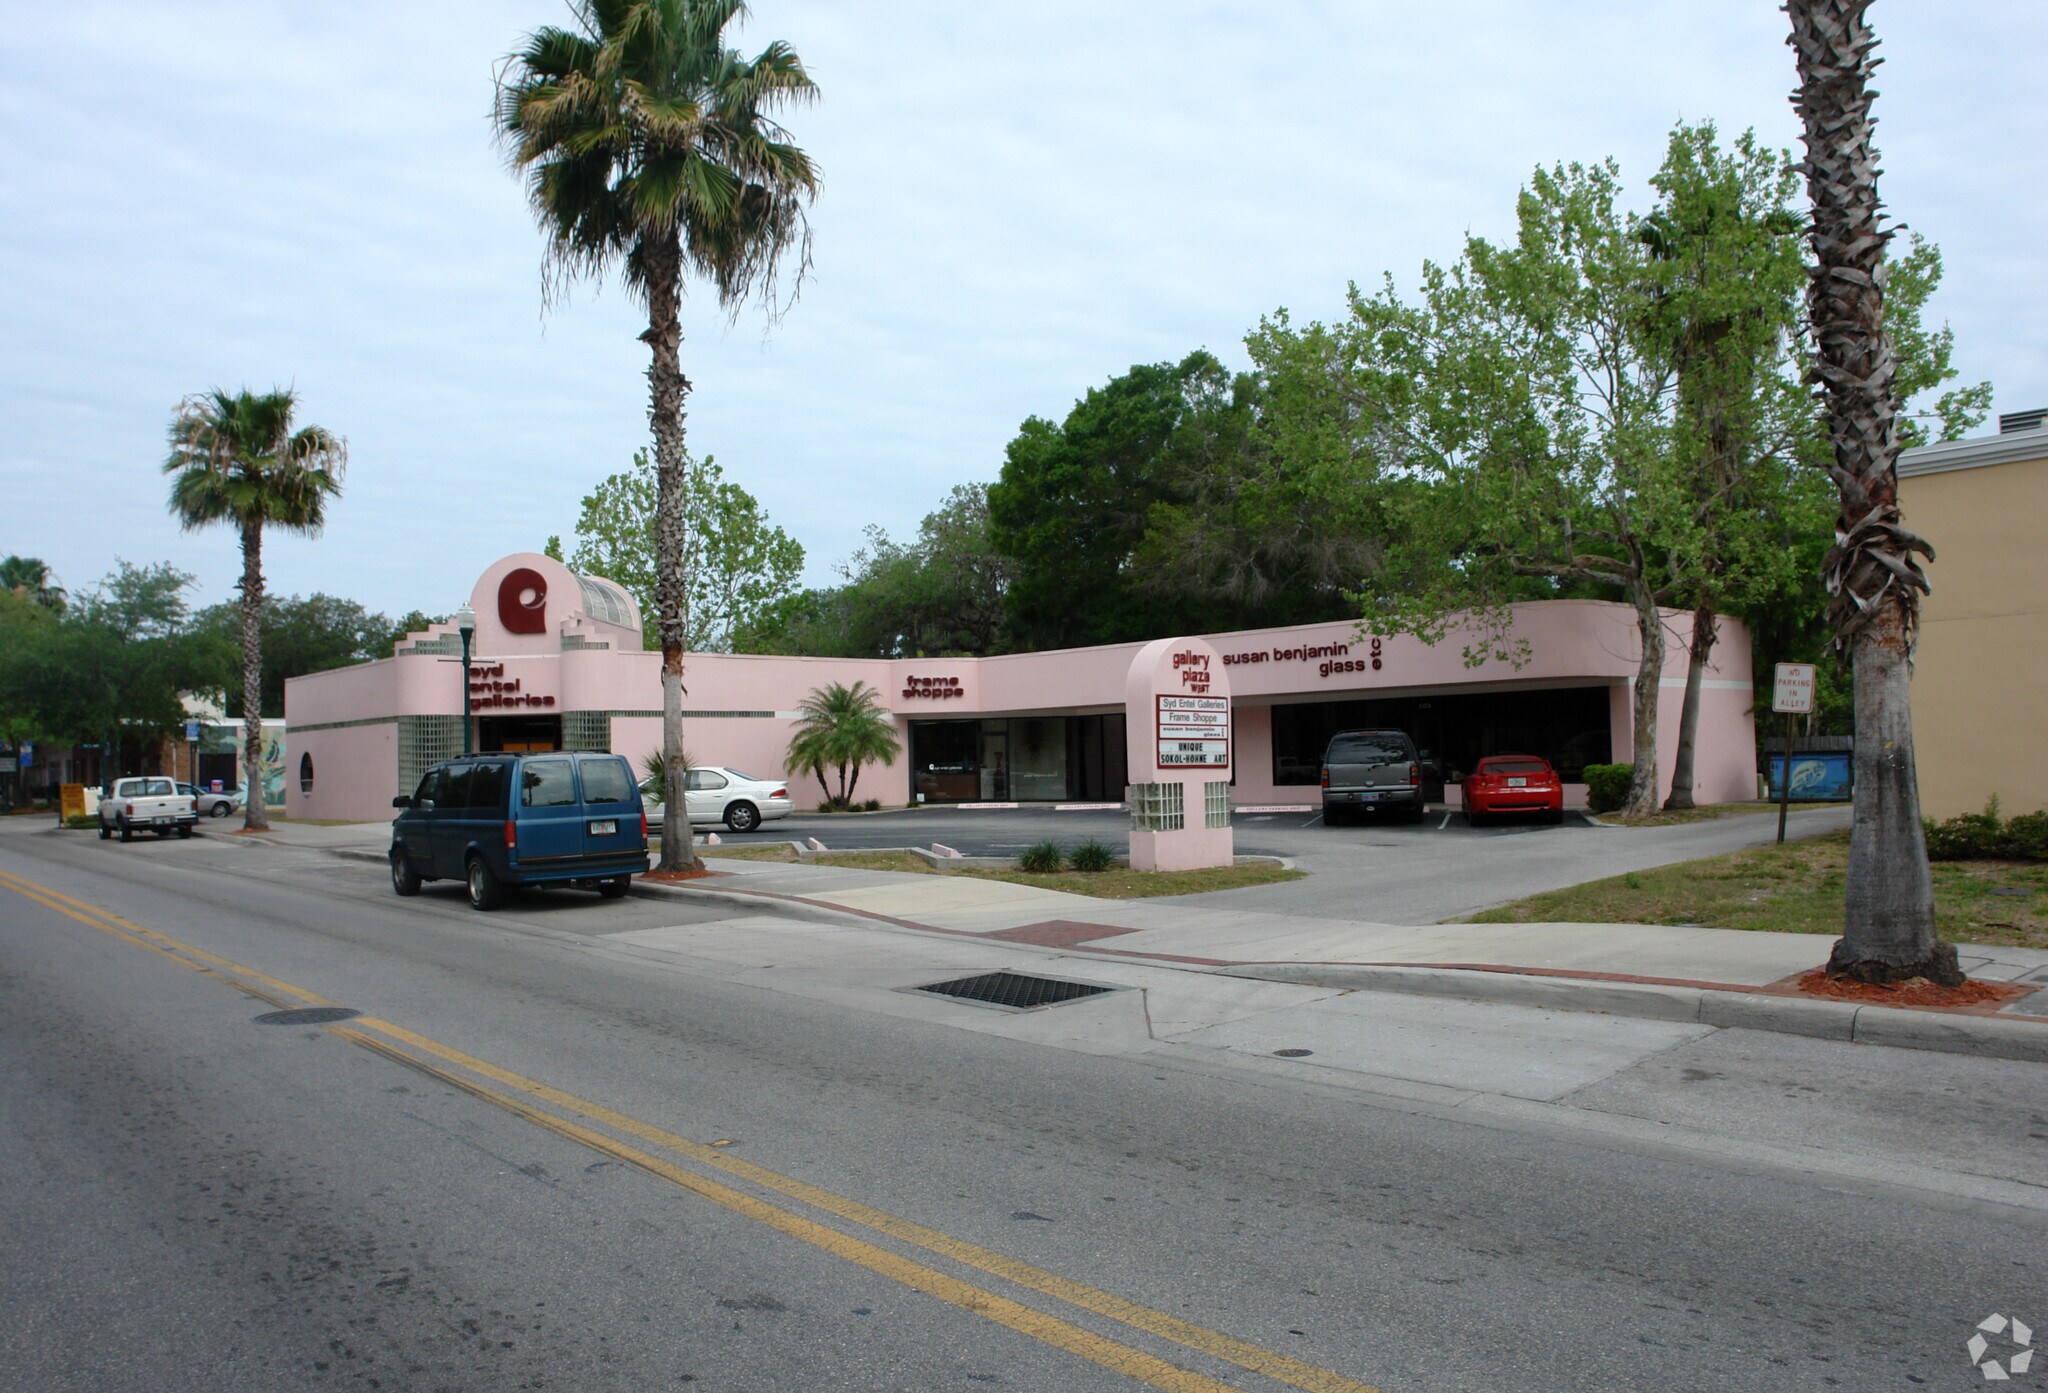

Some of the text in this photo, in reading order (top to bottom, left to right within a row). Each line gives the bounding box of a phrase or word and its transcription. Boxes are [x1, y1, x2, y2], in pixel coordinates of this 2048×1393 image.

[1222, 641, 1349, 666] susan benjamin
[1370, 637, 1382, 670] etc
[1173, 650, 1210, 671] gallery
[469, 663, 504, 680] syd
[1319, 660, 1366, 678] glass
[906, 675, 959, 687] frame
[1182, 667, 1210, 687] plaza
[1778, 678, 1810, 687] PARKING
[469, 678, 520, 693] entel
[1190, 684, 1210, 694] WEST
[902, 686, 964, 700] shoppe
[1789, 689, 1798, 697] IN
[469, 693, 555, 711] galleries
[1163, 698, 1225, 709] Syd Entel Galleries
[1780, 699, 1805, 707] ALLEY
[1169, 712, 1217, 724] Frame Shoppe
[1178, 742, 1203, 751] UNIQUE
[1160, 754, 1226, 763] SOKOL-HOHNE ART
